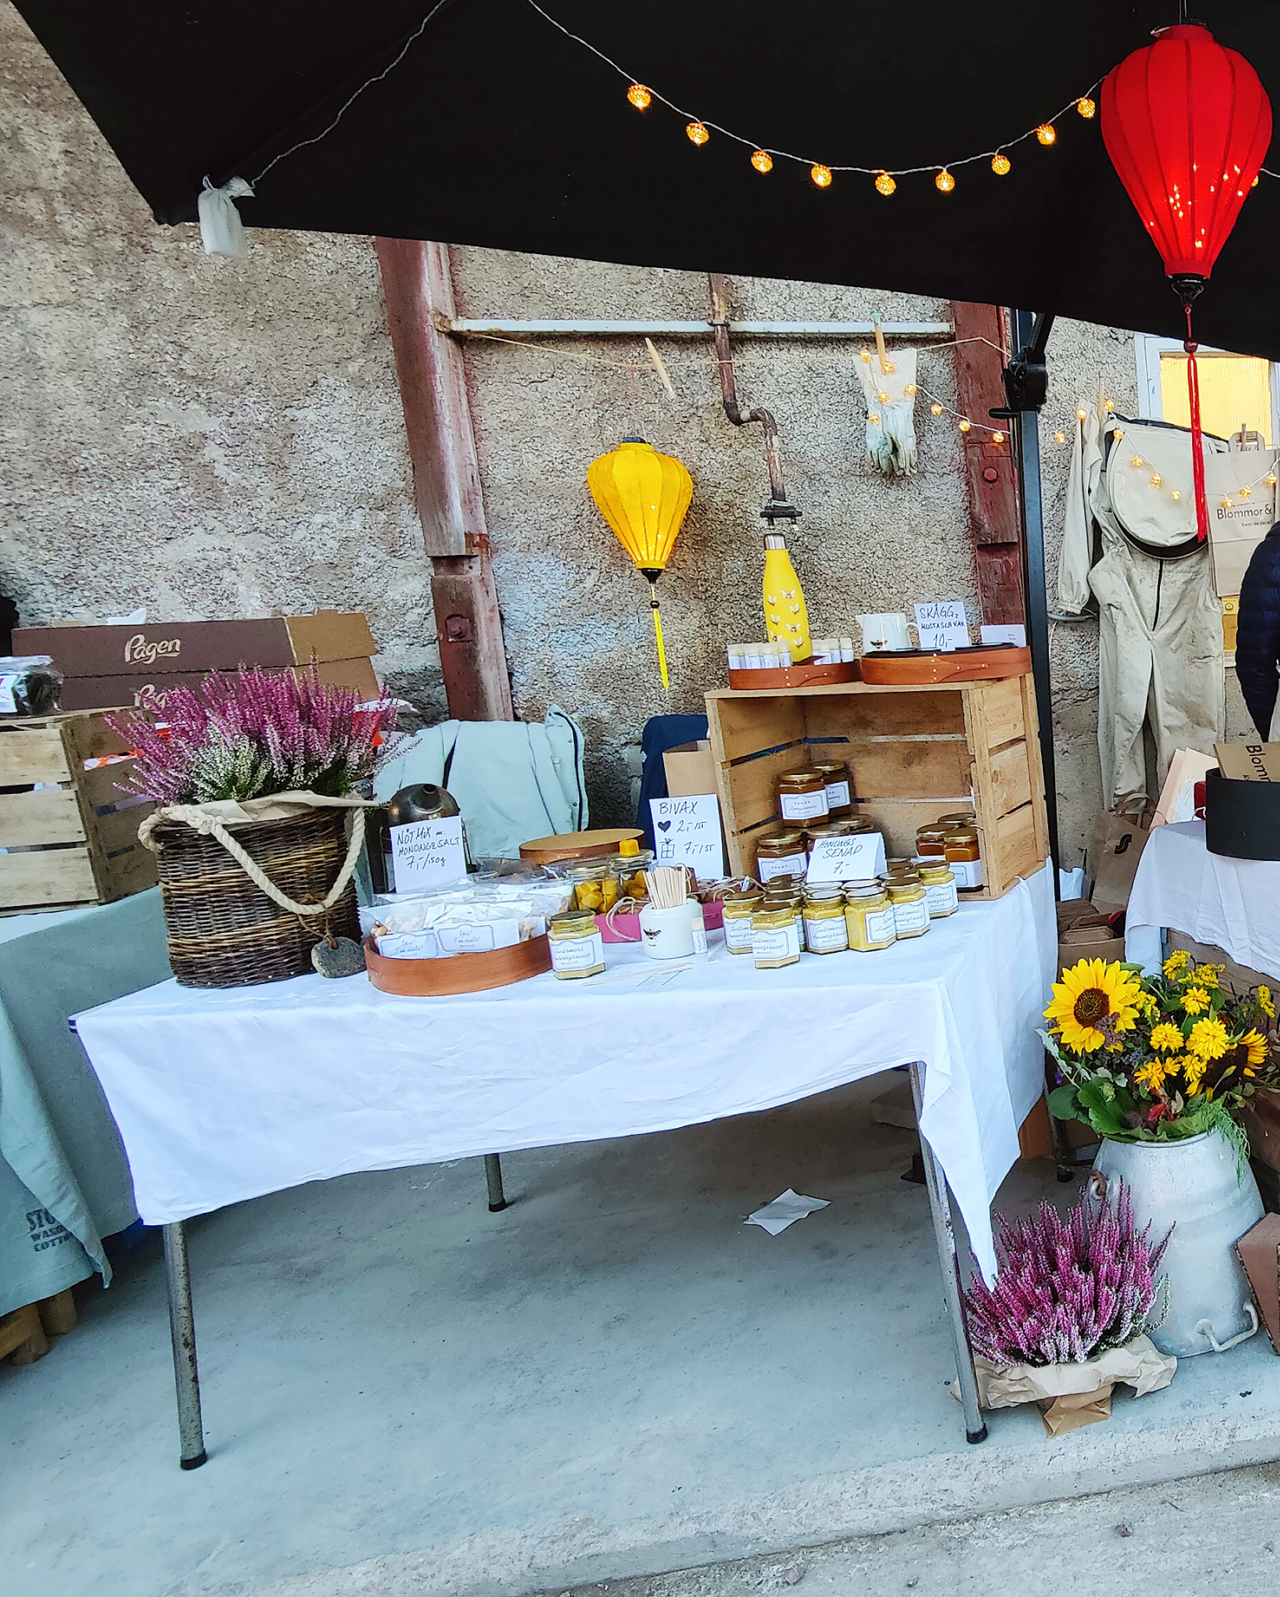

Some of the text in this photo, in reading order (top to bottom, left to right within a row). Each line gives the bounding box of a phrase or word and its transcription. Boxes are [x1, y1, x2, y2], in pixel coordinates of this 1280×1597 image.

[1216, 504, 1264, 520] Blommor
[1264, 503, 1272, 516] &
[124, 634, 181, 665] Pågen
[659, 800, 698, 815] BIVAX
[822, 844, 864, 860] SENAP
